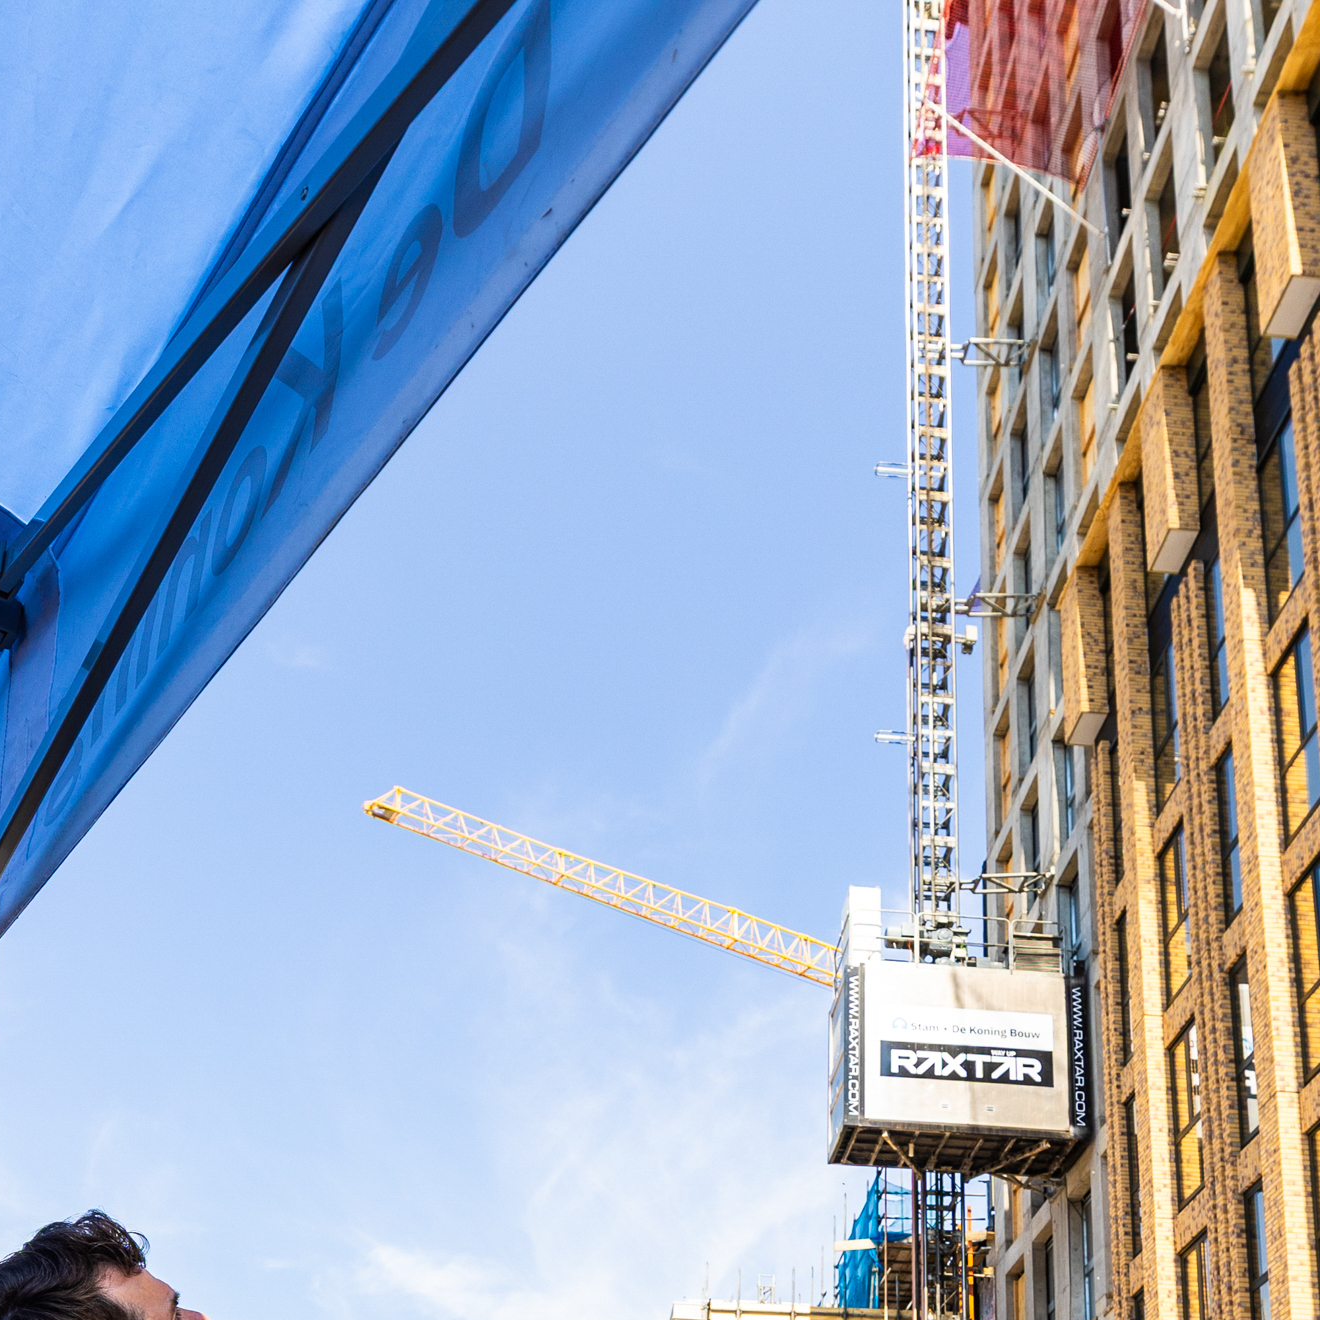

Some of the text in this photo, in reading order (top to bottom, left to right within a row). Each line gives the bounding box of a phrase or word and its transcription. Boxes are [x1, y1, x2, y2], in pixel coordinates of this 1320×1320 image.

[848, 975, 860, 1116] WWW.RAXTAR.COM
[890, 1048, 1042, 1083] RAXTAR
[952, 1025, 966, 1034] De
[969, 1026, 1007, 1039] Koning
[1010, 1029, 1040, 1039] Bouw
[1071, 986, 1086, 1127] WWW.RAXTAR.COM
